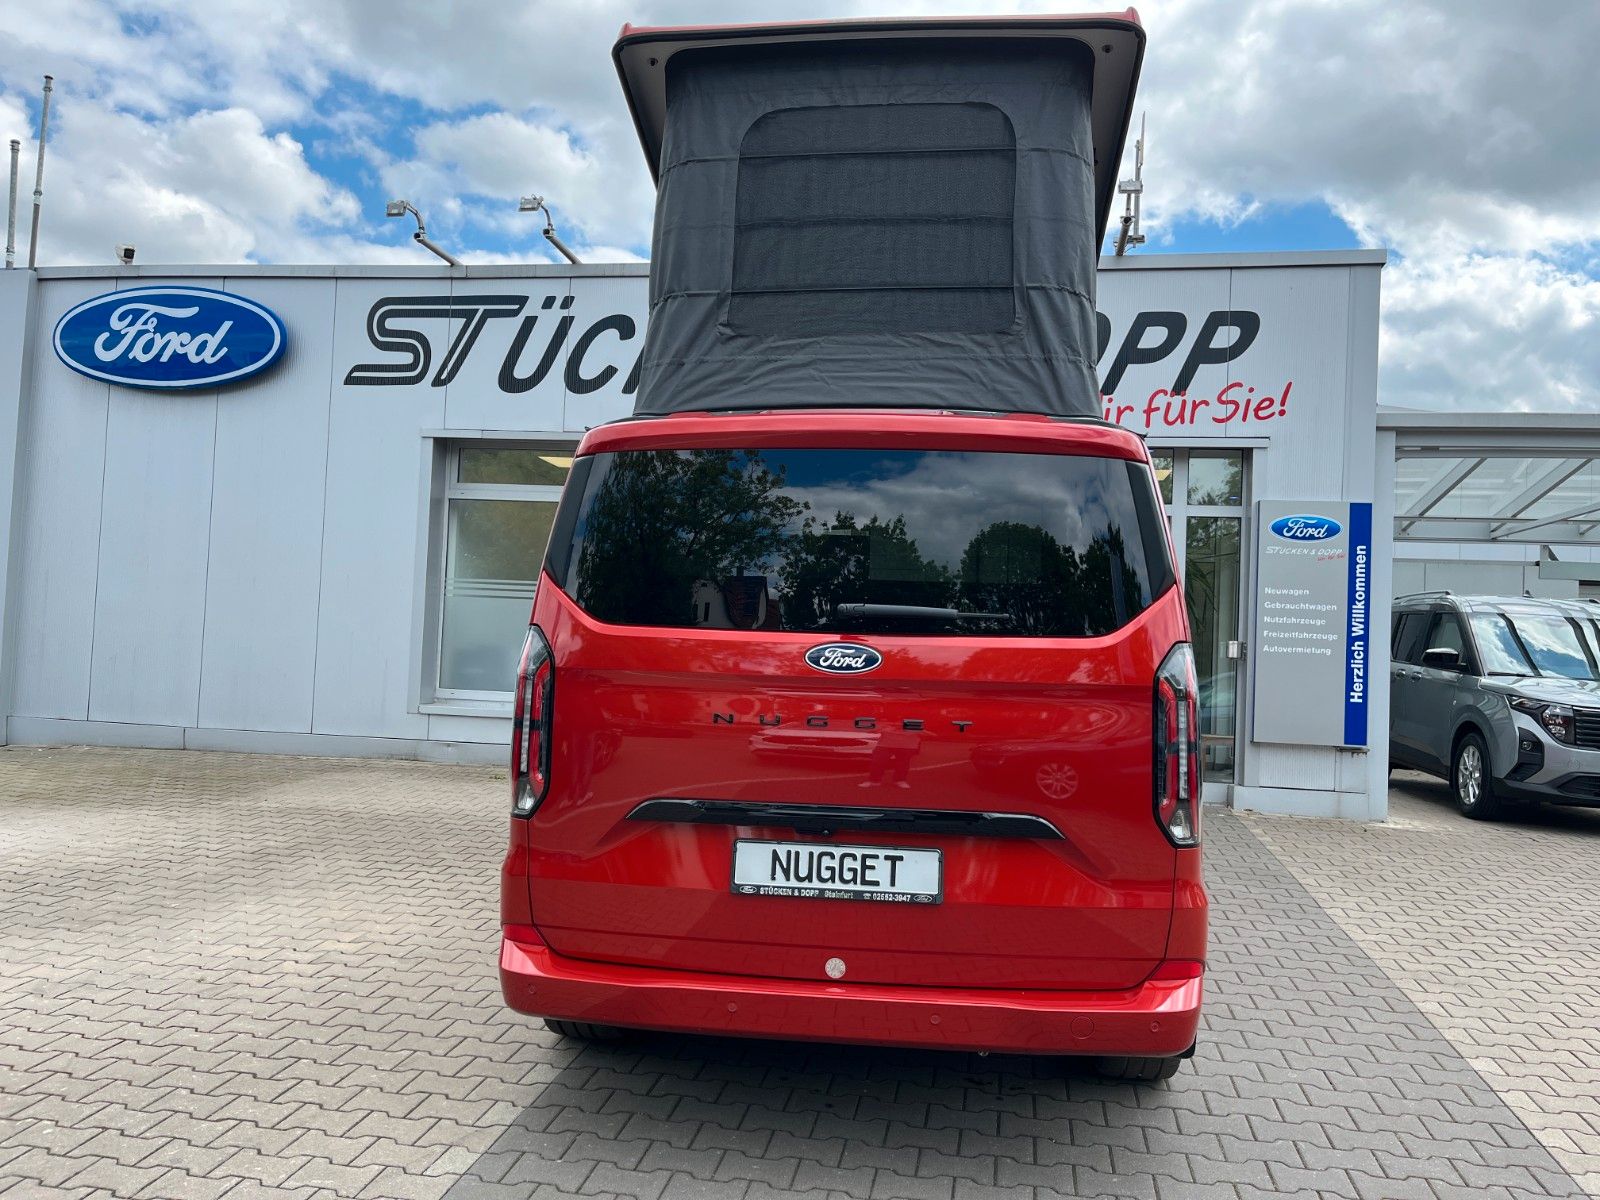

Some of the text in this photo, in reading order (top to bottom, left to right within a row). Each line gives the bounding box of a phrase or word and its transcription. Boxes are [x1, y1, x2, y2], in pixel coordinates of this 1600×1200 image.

[93, 301, 229, 364] Ford
[343, 294, 645, 395] STÜC
[1142, 388, 1210, 429] für
[1211, 380, 1293, 424] Sie!
[1282, 517, 1329, 538] Ford
[1264, 587, 1310, 596] Neuwagen
[1264, 601, 1337, 611] Gebrauchtwagen
[1263, 616, 1327, 626] Nutzfahrzeuge
[1349, 545, 1367, 703] Herzlich Willkommen
[1263, 630, 1338, 641] Freizeitfahrzeuge
[819, 647, 866, 668] Ford
[1263, 644, 1332, 656] Autovermietung
[712, 712, 974, 733] NUGGET
[770, 849, 904, 887] NUGGET
[800, 889, 819, 897] DOPP
